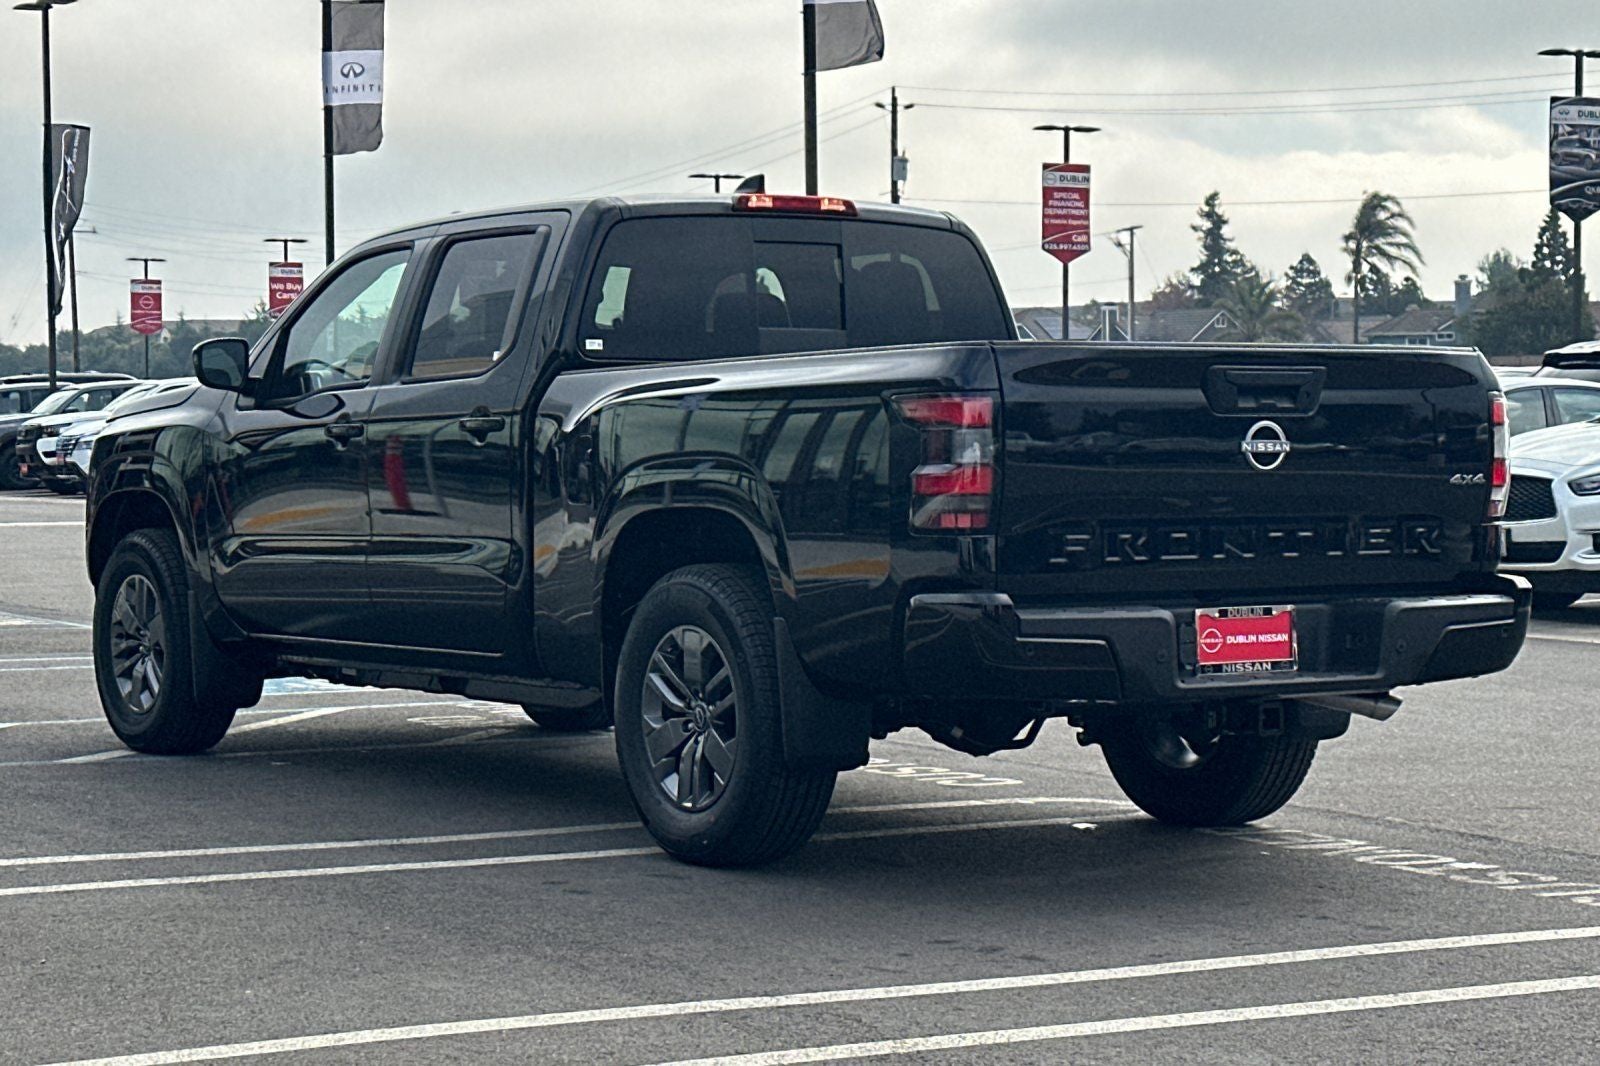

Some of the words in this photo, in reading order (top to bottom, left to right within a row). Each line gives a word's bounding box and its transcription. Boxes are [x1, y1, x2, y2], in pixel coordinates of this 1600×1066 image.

[325, 84, 381, 93] INFINITI
[1059, 174, 1090, 183] DUBLIN
[270, 282, 285, 290] We
[285, 282, 303, 292] Buy
[1241, 441, 1290, 452] NISSAN
[1048, 524, 1442, 564] FRONTIER
[1227, 607, 1264, 618] DUBLIN
[1226, 634, 1256, 644] DUBLIN
[1257, 633, 1289, 643] NISSAN
[1222, 662, 1272, 673] NISSAN
